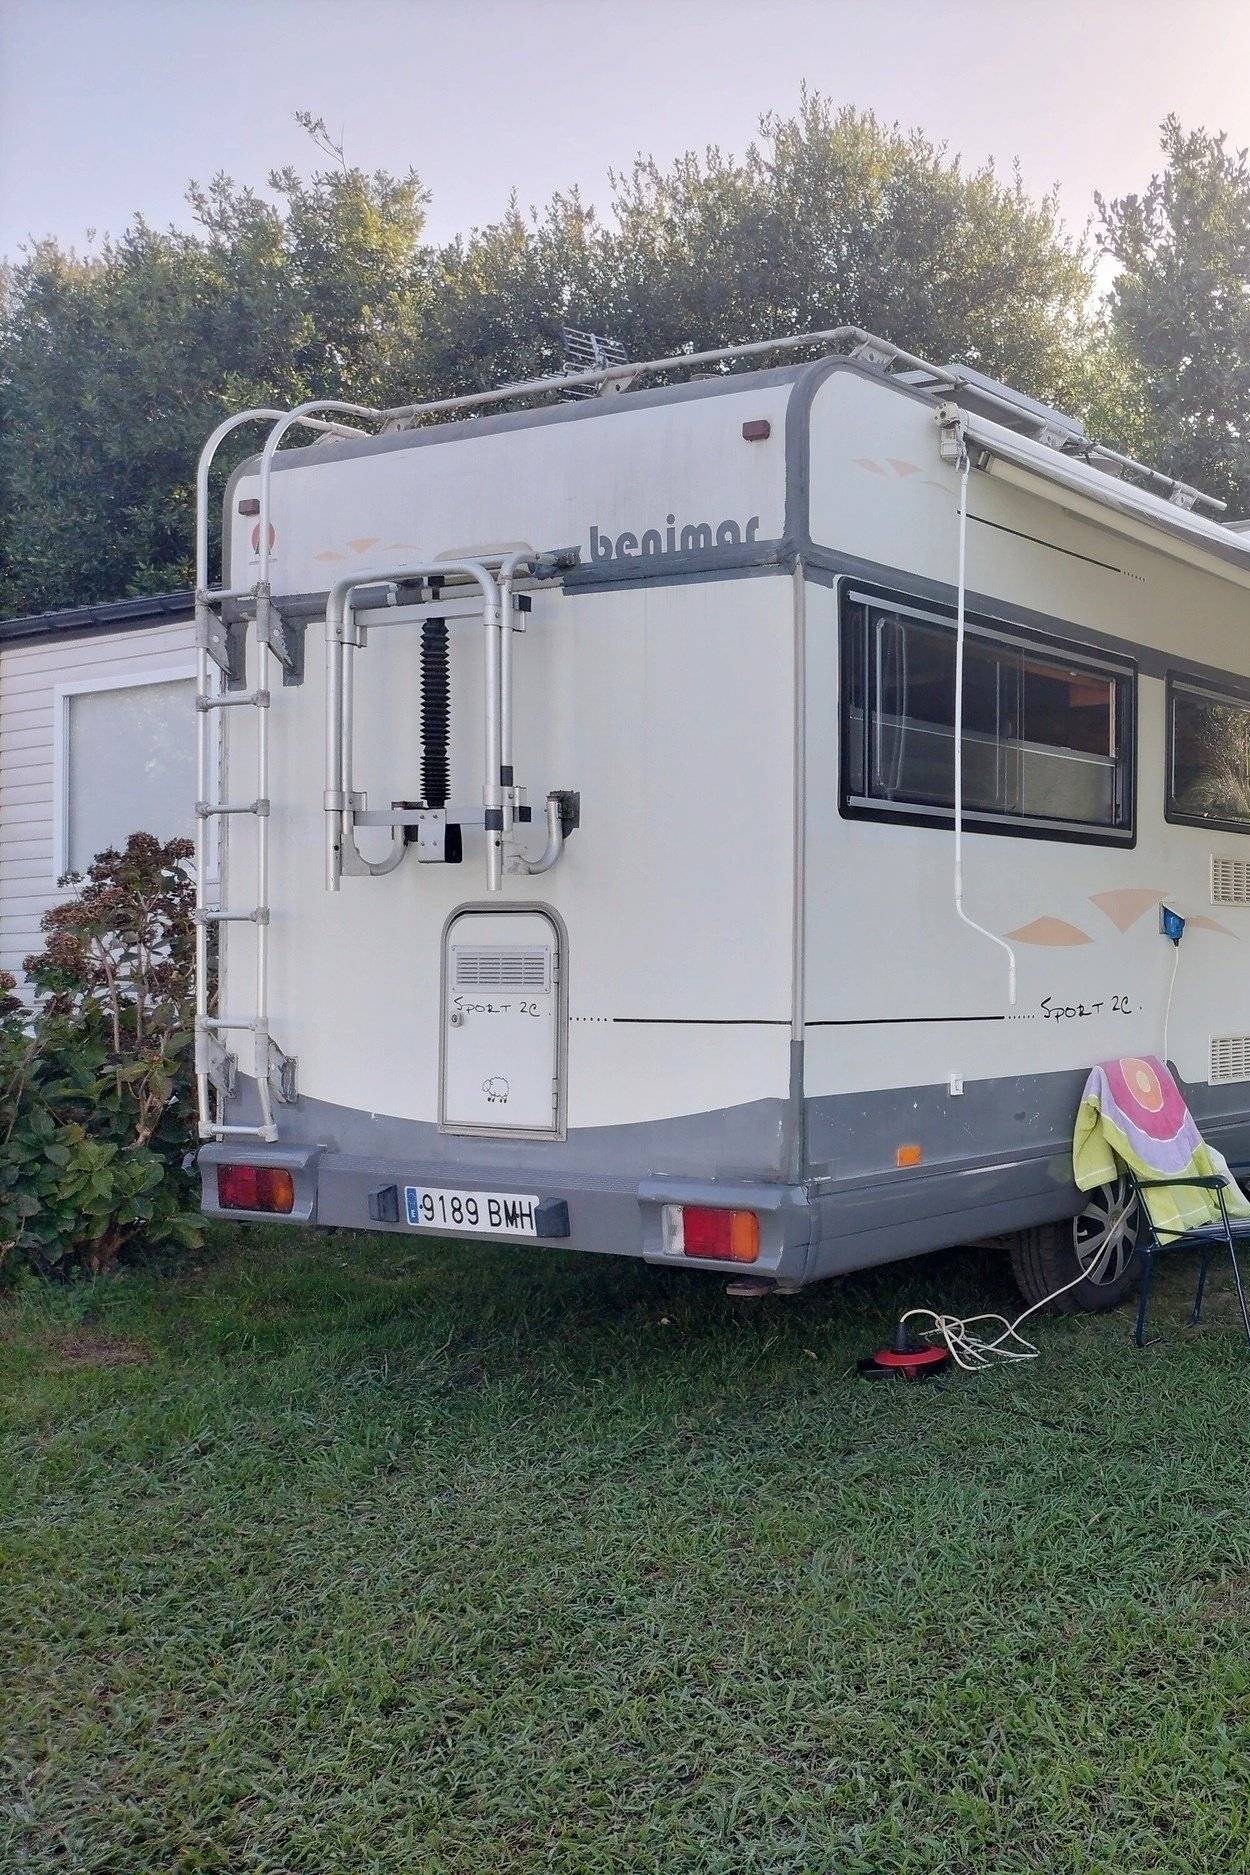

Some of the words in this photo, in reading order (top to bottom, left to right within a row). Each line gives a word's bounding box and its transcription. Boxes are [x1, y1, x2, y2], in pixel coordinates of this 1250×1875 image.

[589, 513, 760, 563] benimar
[422, 1193, 480, 1226] 9189
[487, 1199, 535, 1231] BMH
